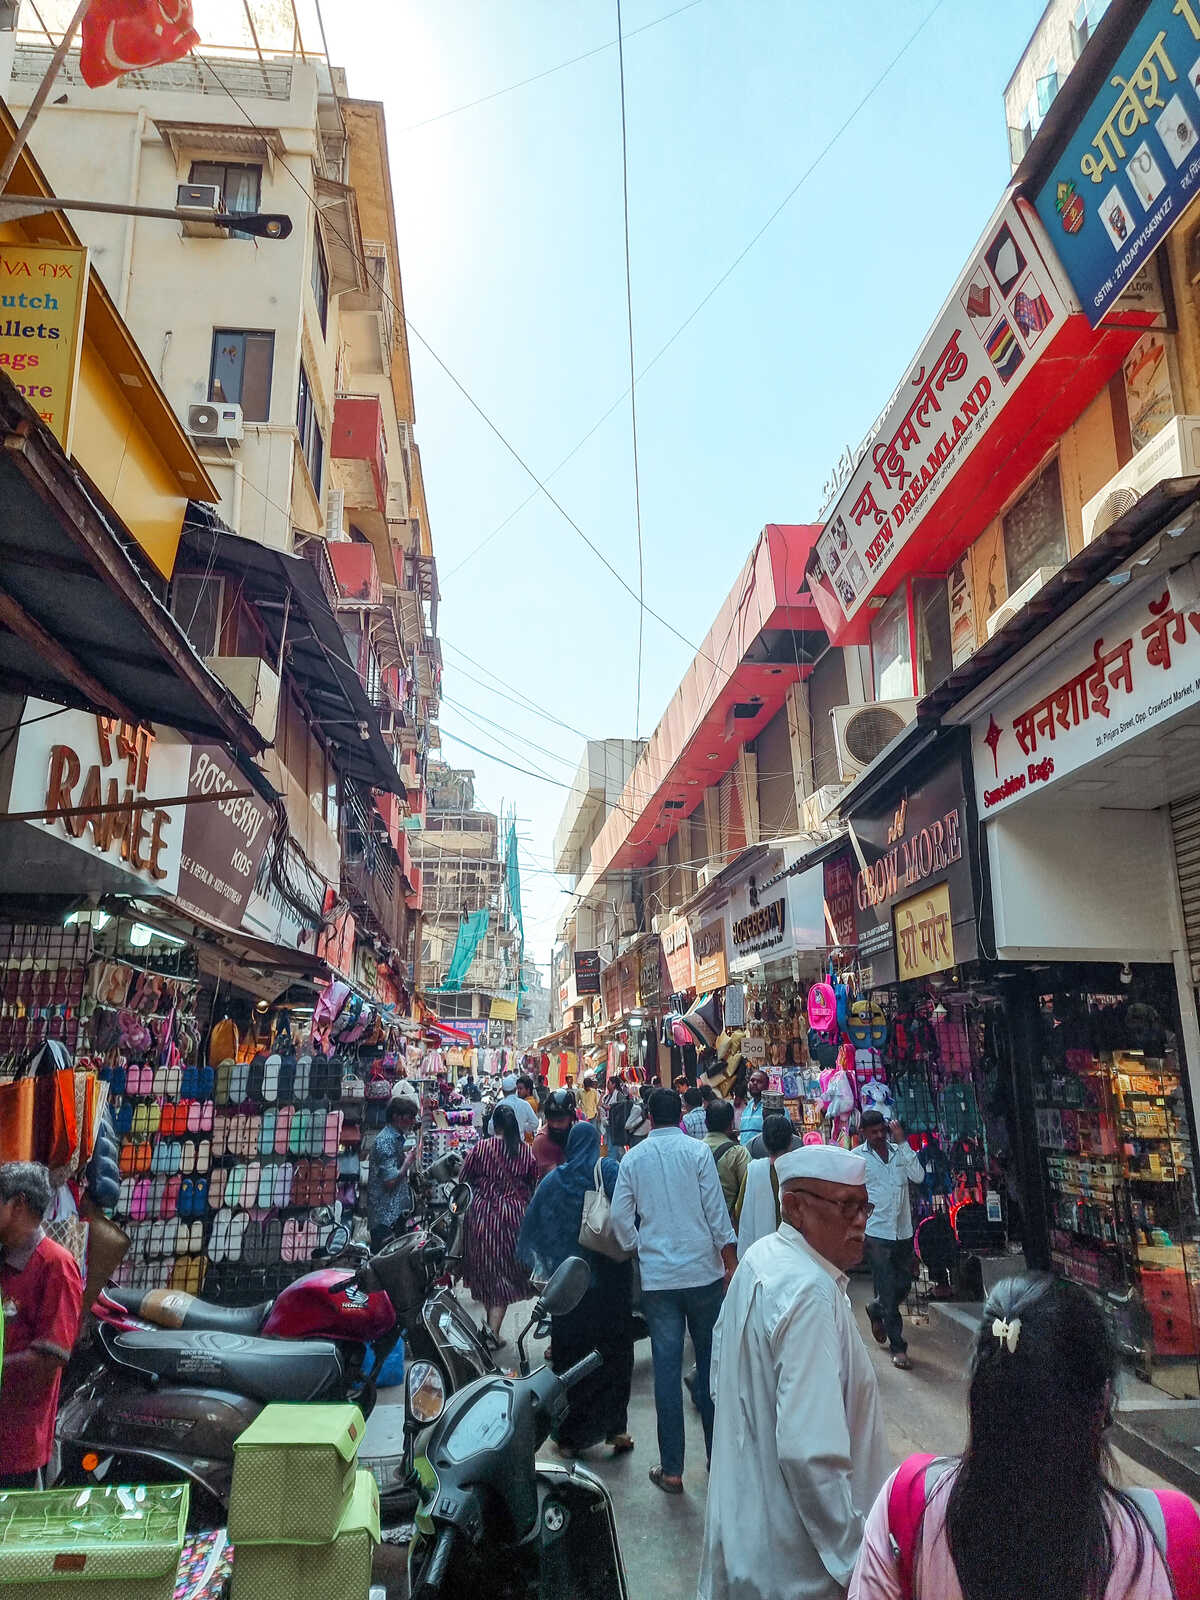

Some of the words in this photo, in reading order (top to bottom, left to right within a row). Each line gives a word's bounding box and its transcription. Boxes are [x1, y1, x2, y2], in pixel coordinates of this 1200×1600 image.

[1080, 31, 1177, 183] भावेश
[0, 255, 32, 277] VA
[1093, 278, 1114, 307] GSTIN
[0, 353, 40, 371] ags
[864, 518, 895, 569] NEW
[891, 374, 992, 529] DREAMLAND
[849, 481, 888, 527] न्यू
[1012, 637, 1134, 756] सनशाईन
[1147, 694, 1173, 716] Crawford
[1173, 683, 1195, 703] Market,
[1027, 757, 1055, 784] Bags
[45, 744, 172, 880] RAMEE
[230, 847, 253, 877] KIDS
[857, 847, 898, 912] GROW
[902, 808, 962, 888] MORE
[833, 915, 854, 937] OUSE
[918, 900, 950, 964] मोर
